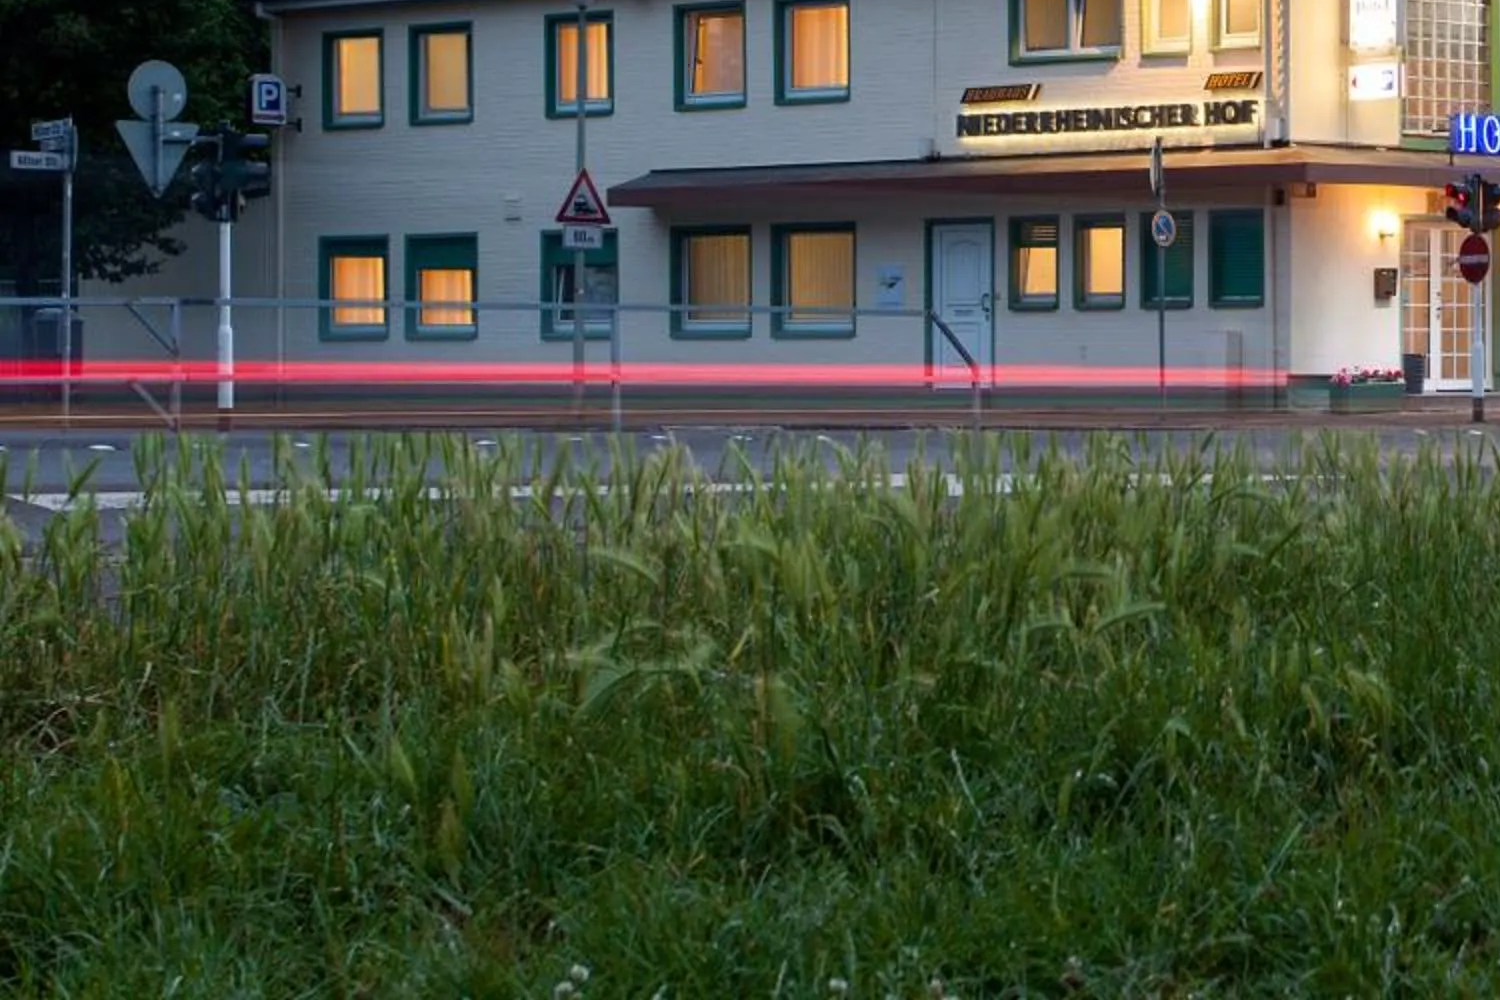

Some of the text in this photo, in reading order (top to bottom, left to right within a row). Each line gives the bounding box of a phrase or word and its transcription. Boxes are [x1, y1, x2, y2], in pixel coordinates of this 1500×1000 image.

[1208, 73, 1251, 89] HOTEL
[261, 83, 279, 108] P
[957, 100, 1259, 137] NIEDERRHEINISCHER HOF
